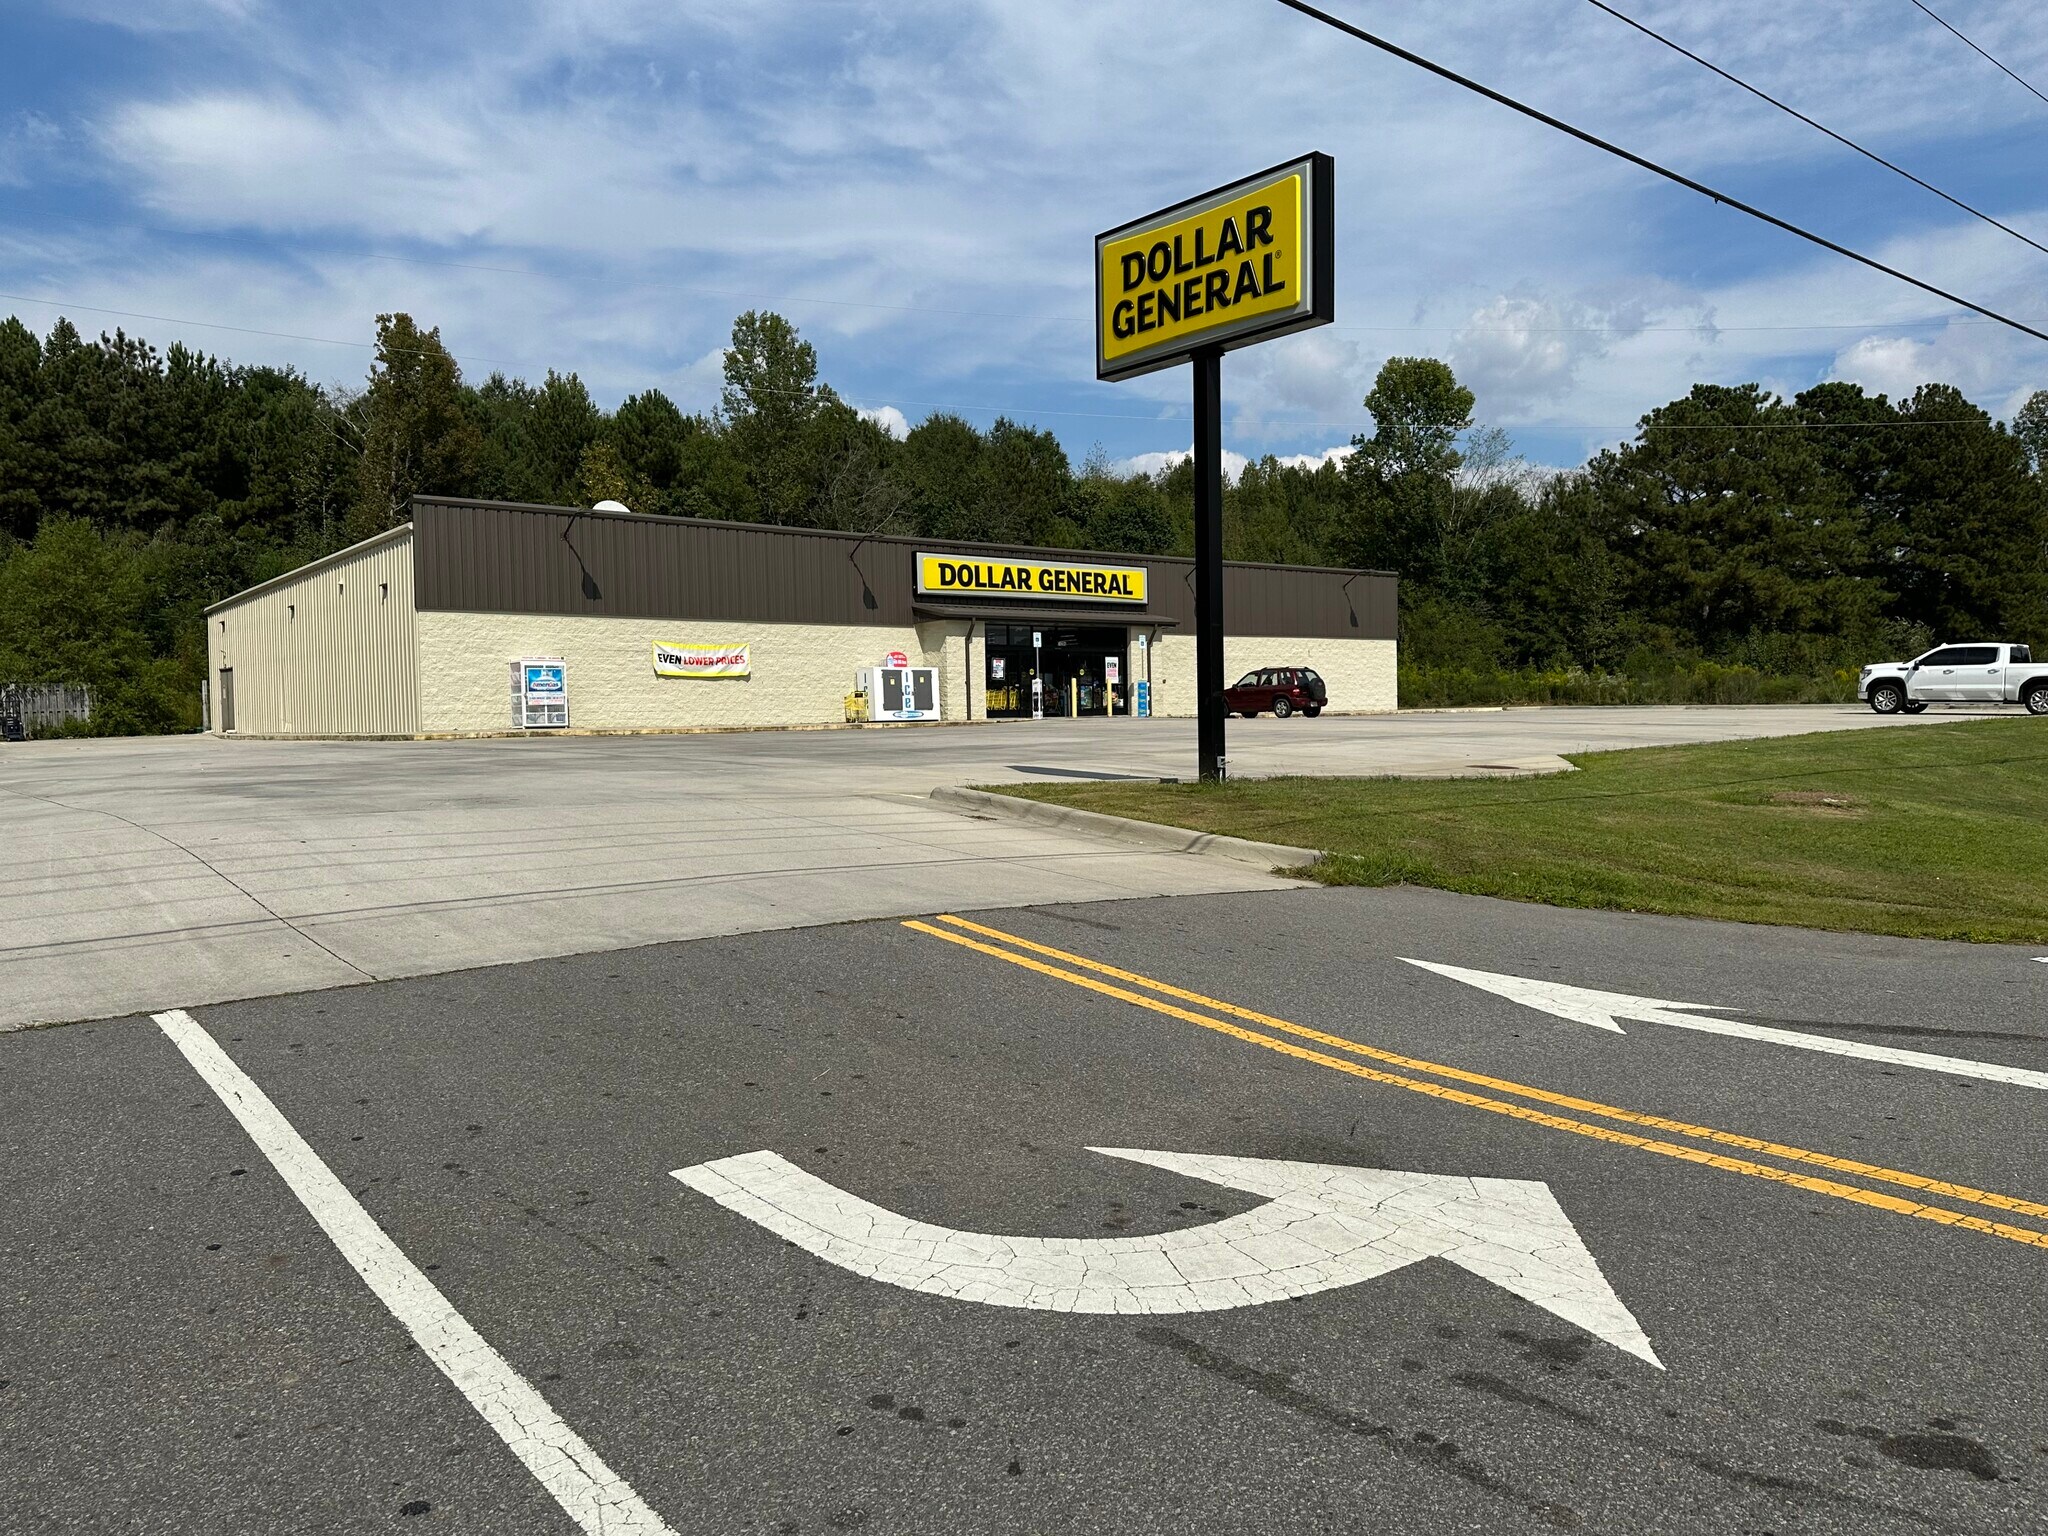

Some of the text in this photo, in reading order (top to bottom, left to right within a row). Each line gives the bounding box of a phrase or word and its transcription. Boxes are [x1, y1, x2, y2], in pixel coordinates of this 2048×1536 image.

[1120, 205, 1274, 292] DOLLAR
[1112, 252, 1286, 340] GENERAL
[938, 562, 1134, 596] DOLLAR GENERAL
[657, 653, 746, 666] EVEN LOWER PRICES
